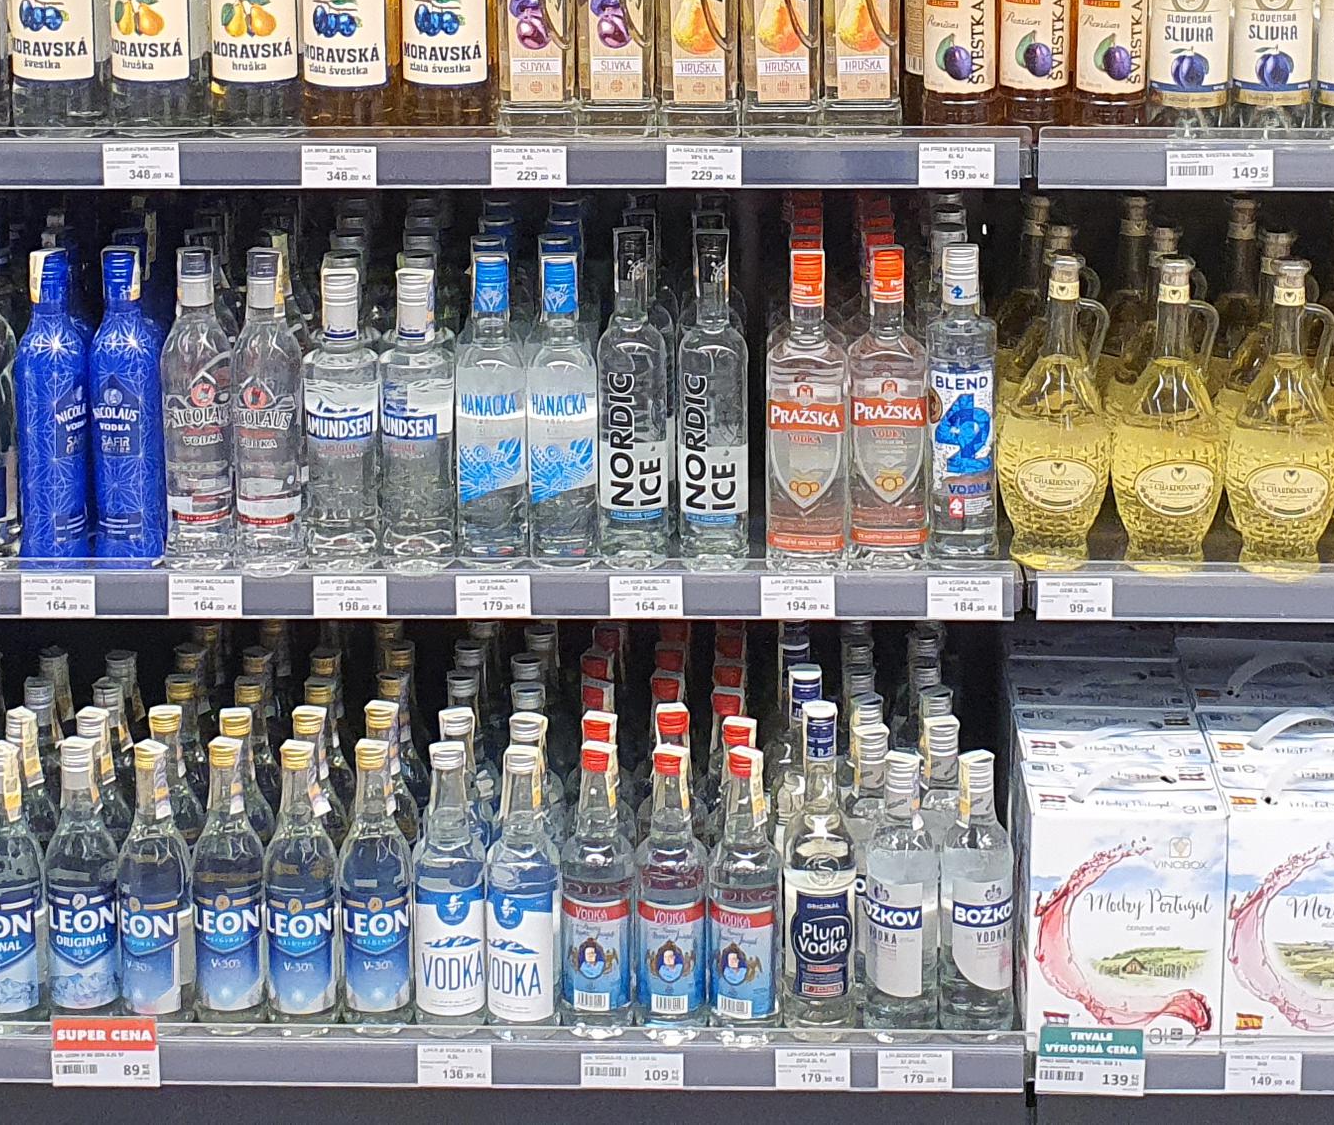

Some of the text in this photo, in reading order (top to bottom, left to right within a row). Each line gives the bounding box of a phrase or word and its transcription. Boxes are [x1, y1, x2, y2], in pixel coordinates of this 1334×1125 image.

[520, 61, 551, 72] SLIVKA
[601, 60, 631, 71] SLIVKA
[680, 58, 718, 74] HRUŠKA
[765, 58, 802, 74] HRUŠKA
[1232, 166, 1257, 179] 149
[935, 375, 988, 391] BLEND
[771, 404, 840, 429] PRAŽSKÁ
[853, 401, 922, 422] PRAŽSKÁ
[307, 415, 372, 440] AMUNDSEN
[101, 436, 130, 448] SAFIR
[608, 372, 635, 508] NORDIC
[684, 372, 708, 510] NORDIC
[640, 458, 663, 507] ICE
[710, 461, 737, 510] ICE
[948, 482, 991, 495] VODKA
[1153, 859, 1207, 871] VINOBOX
[1147, 888, 1213, 921] Portugal
[49, 903, 115, 931] LEON
[195, 907, 259, 936] LEON
[56, 933, 108, 947] ORIGINAL
[802, 921, 845, 943] Plum
[797, 935, 849, 954] Vodka
[421, 951, 484, 989] VODKA
[56, 1027, 153, 1042] SUPER CENA
[1070, 1031, 1113, 1041] TRVALE
[1045, 1041, 1137, 1055] VÝHODNÁ CENA
[123, 1064, 140, 1076] 89
[643, 1068, 669, 1081] 109
[1101, 1073, 1129, 1085] 139
